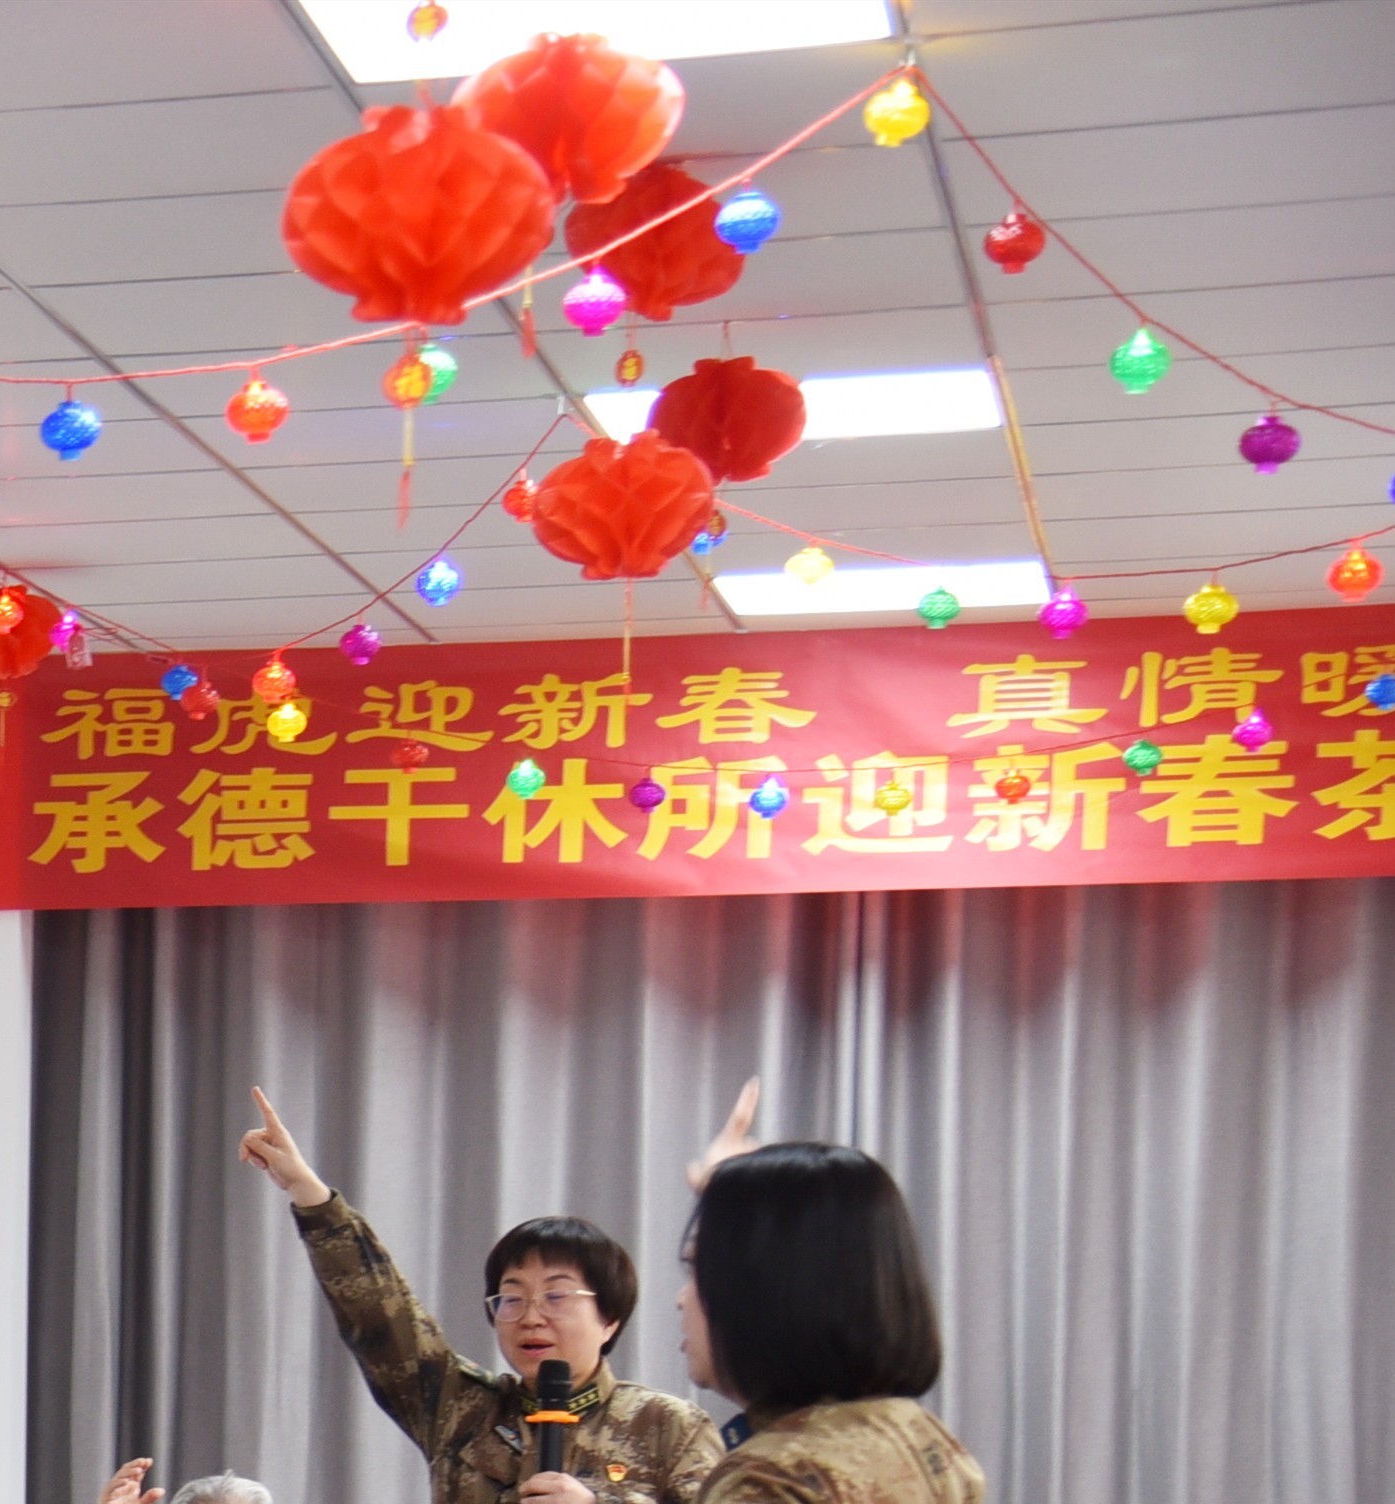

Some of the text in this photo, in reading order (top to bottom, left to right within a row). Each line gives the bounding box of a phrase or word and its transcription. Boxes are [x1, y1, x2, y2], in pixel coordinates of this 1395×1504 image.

[40, 667, 817, 759] 福虎迎新春
